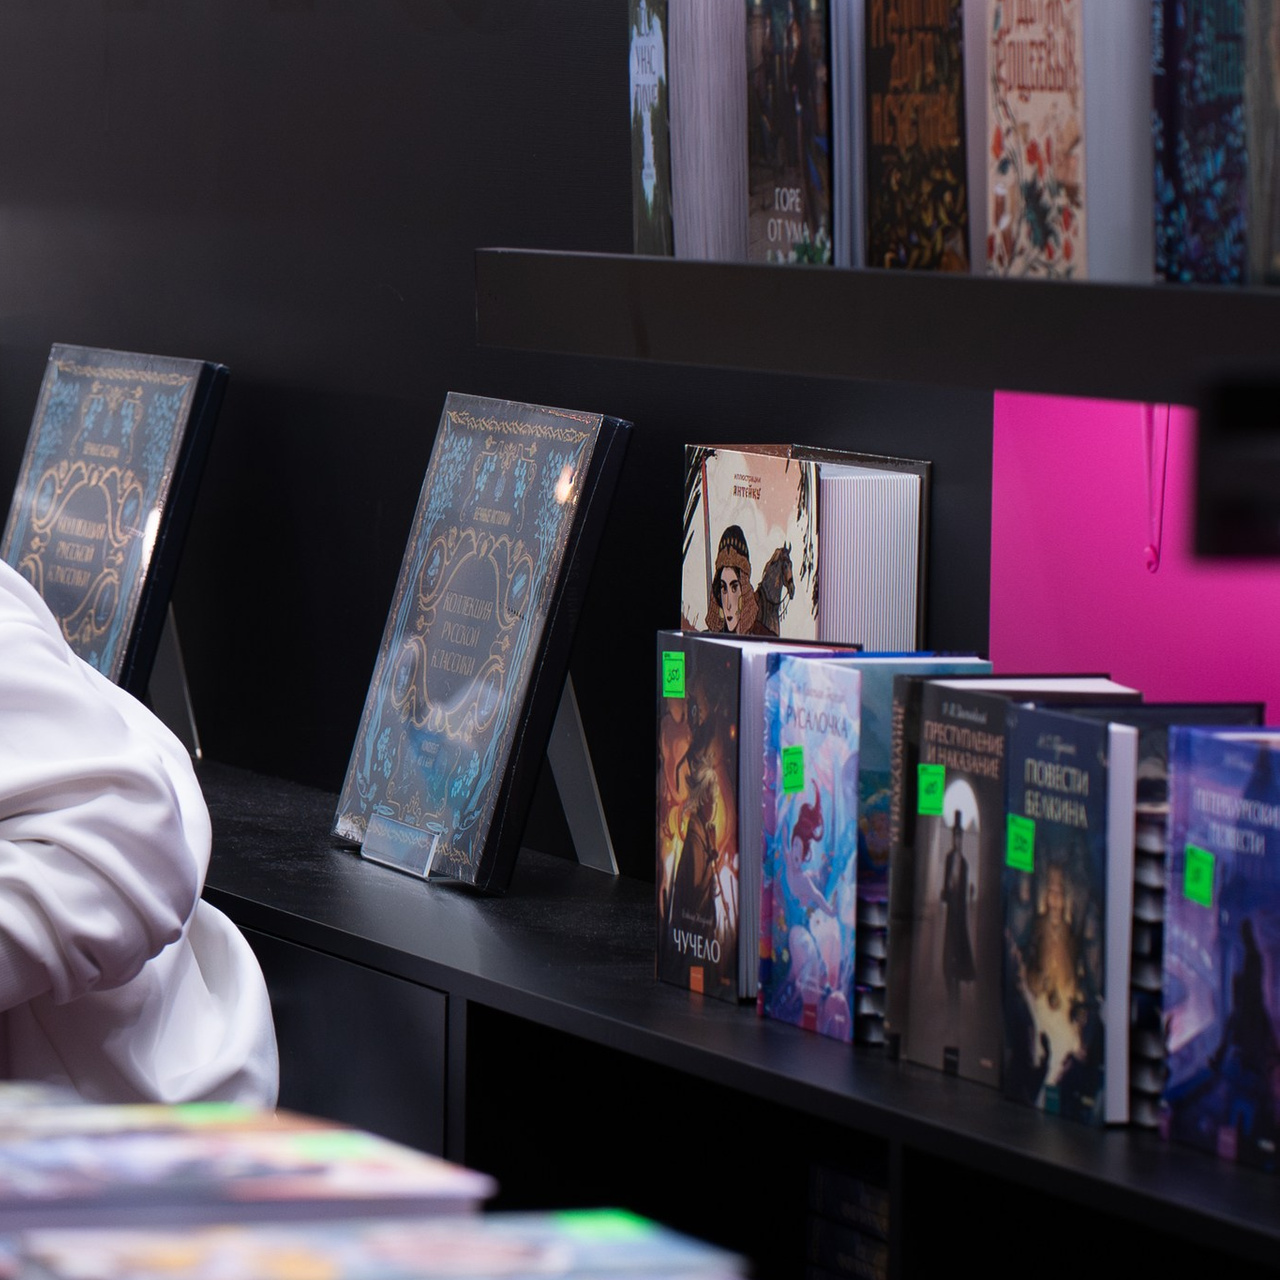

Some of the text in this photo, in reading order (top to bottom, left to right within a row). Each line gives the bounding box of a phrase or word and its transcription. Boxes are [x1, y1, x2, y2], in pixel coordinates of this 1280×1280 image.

[774, 186, 802, 213] ГОРЕ
[767, 218, 783, 242] ОТ
[55, 540, 95, 563] РУССКОЙ
[47, 564, 91, 587] КЛАССИКИ
[442, 591, 494, 621] КОЛЛЕКЦИЯ
[440, 620, 481, 648] РУССКОЙ
[430, 648, 476, 677] КЛАССИКИ
[786, 704, 848, 738] РУСАЛОЧКА
[924, 720, 1005, 757] ПРЕСТУПЛЕНИЕ
[938, 747, 1000, 780] НАКАЗАНИЕ
[1024, 757, 1089, 797] ПОВЕСТИ
[1024, 789, 1089, 829] БЕЛКИНА
[673, 927, 721, 964] ЧУЧЕЛО
